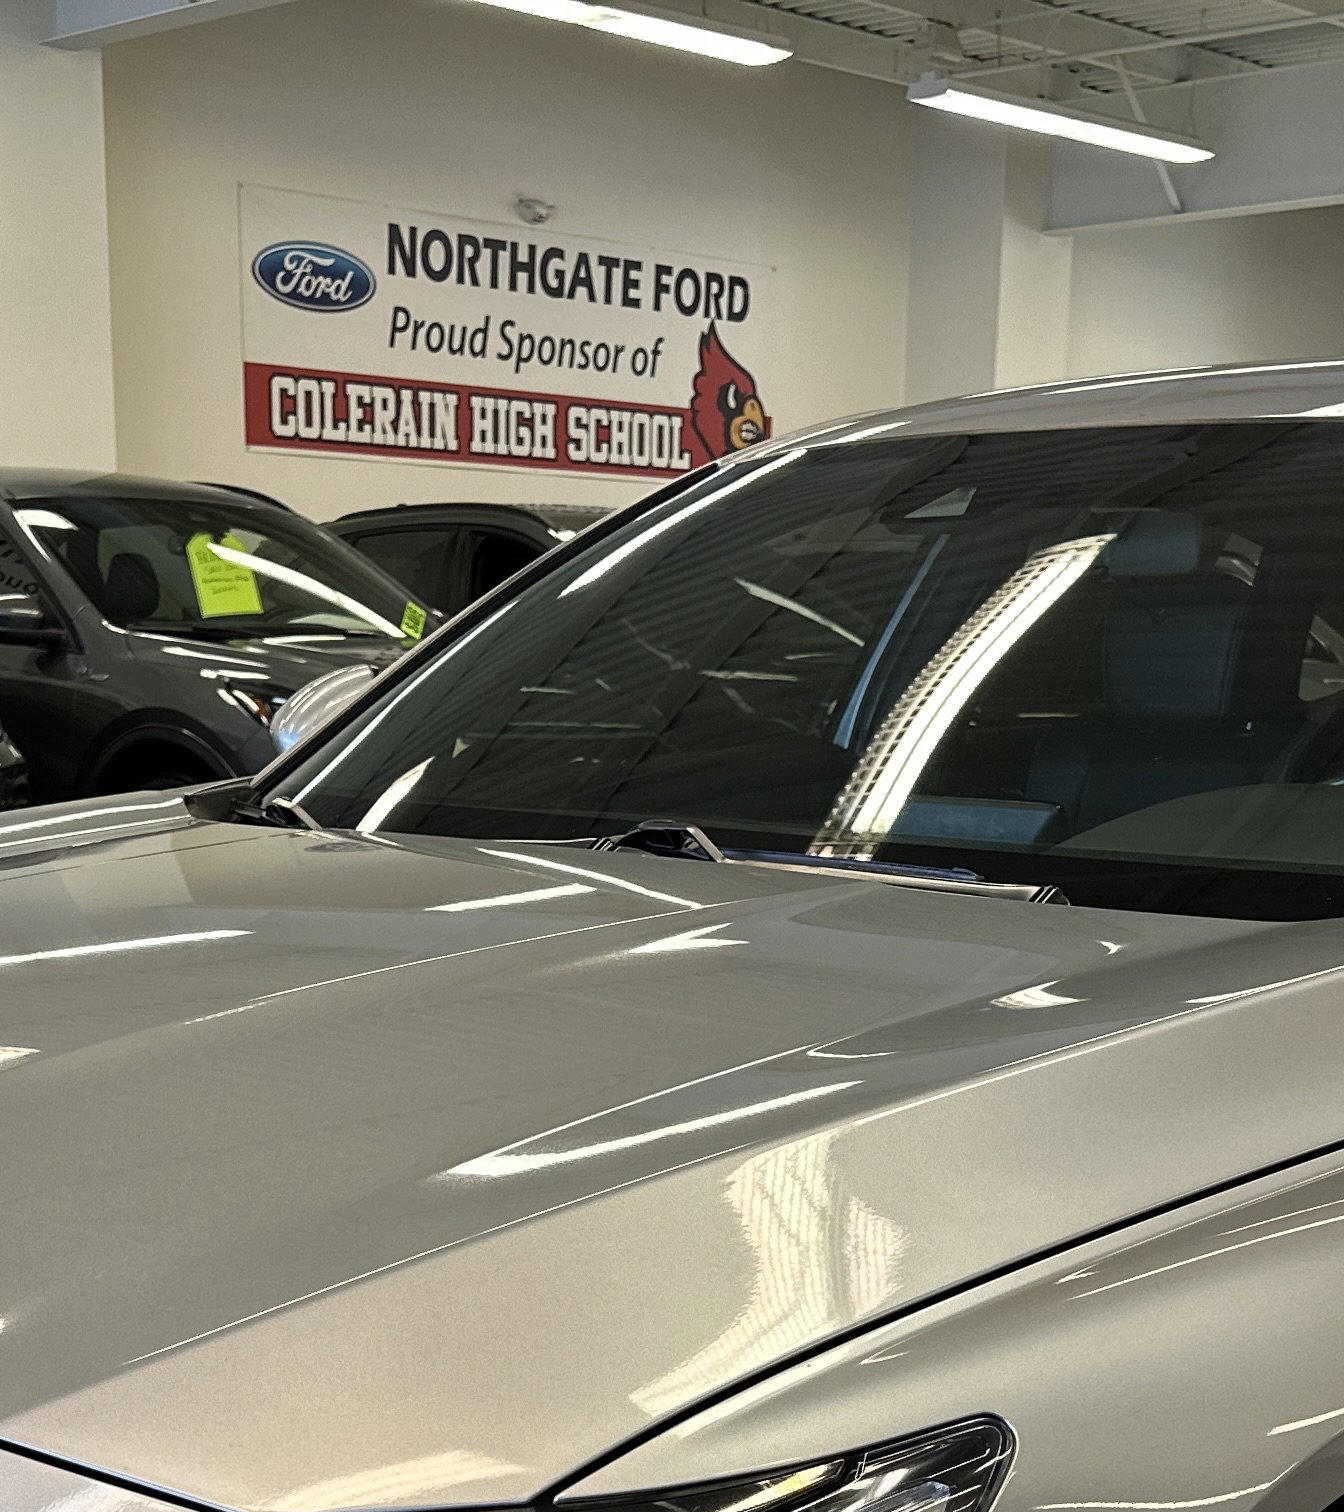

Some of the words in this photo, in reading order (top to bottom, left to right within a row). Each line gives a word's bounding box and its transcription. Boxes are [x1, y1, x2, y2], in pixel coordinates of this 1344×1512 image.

[275, 249, 354, 302] Ford
[387, 223, 642, 310] NORTHGATE
[653, 264, 750, 323] FORD
[388, 306, 488, 359] Proud
[499, 318, 623, 375] Sponsor
[630, 337, 665, 378] of
[268, 373, 460, 453] COLERAIN
[469, 395, 557, 461] HIGH
[566, 406, 691, 471] SCHOOL
